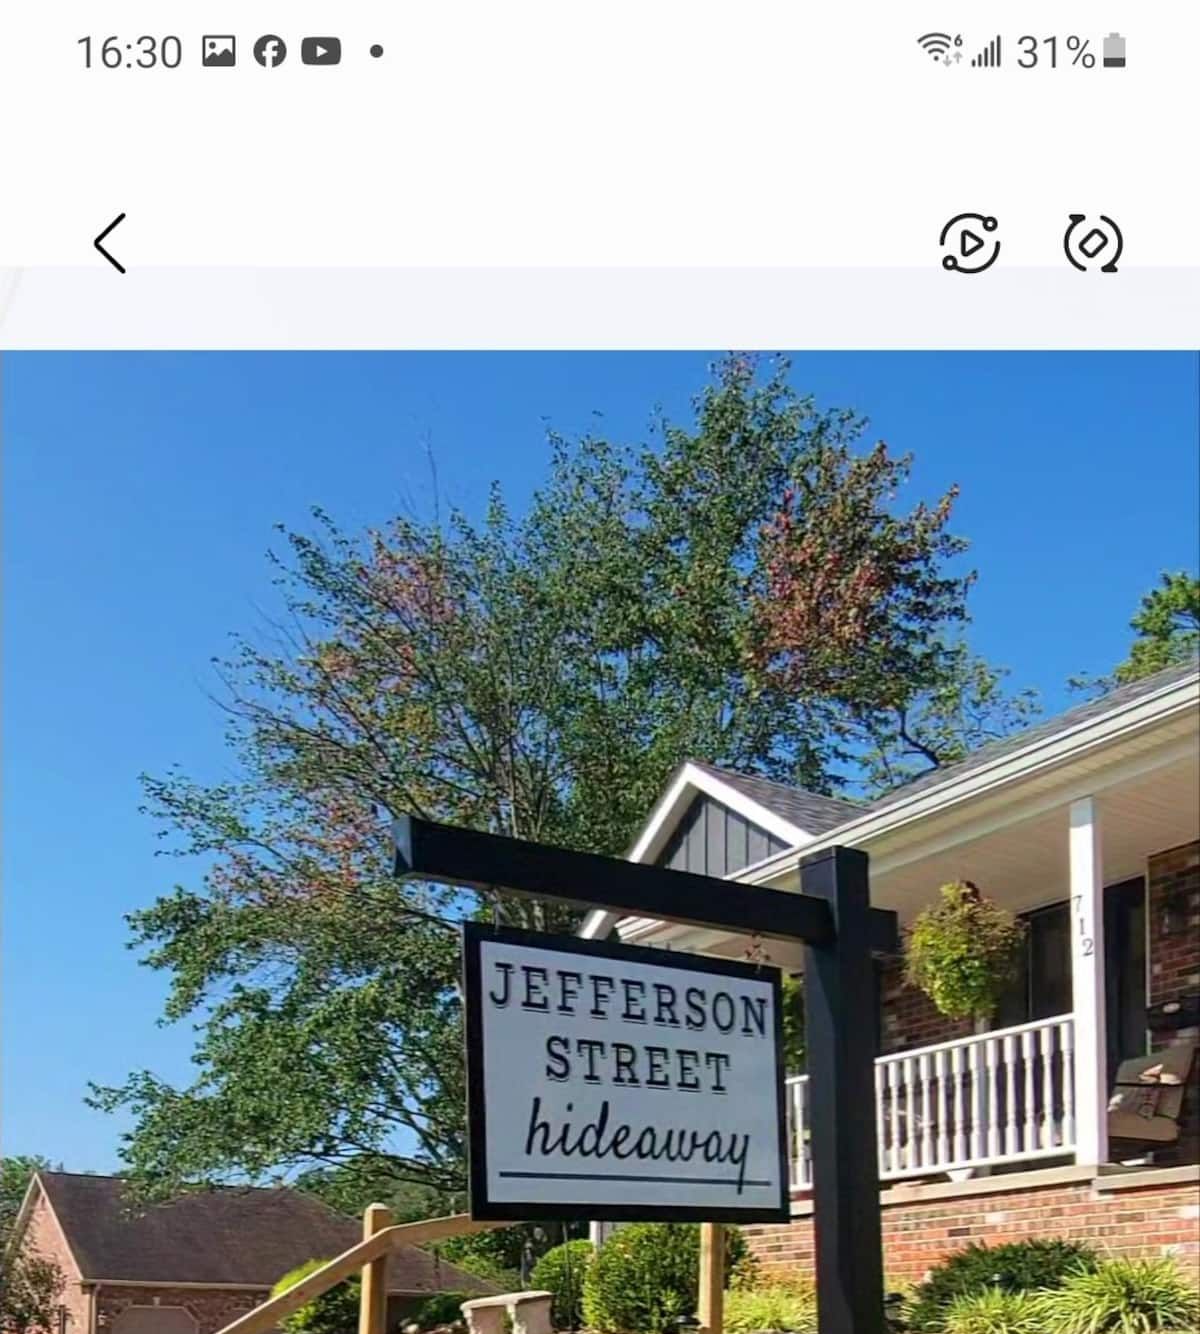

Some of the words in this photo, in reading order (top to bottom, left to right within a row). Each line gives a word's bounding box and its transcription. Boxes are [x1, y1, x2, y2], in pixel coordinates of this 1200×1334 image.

[1072, 894, 1094, 957] 712
[488, 962, 769, 1040] JEFFERSON
[545, 1036, 730, 1096] STREET
[525, 1096, 750, 1195] hideaway
